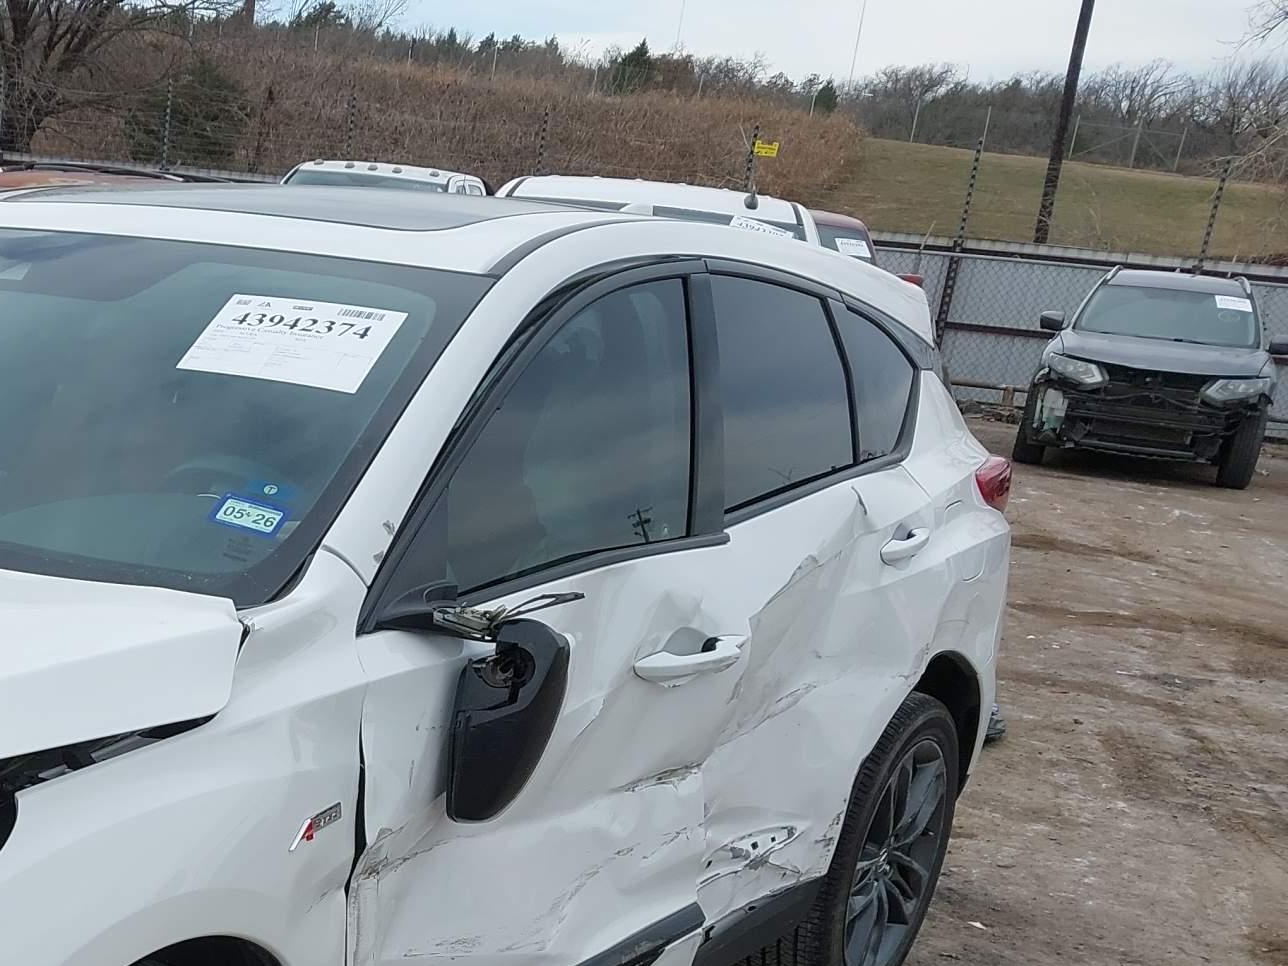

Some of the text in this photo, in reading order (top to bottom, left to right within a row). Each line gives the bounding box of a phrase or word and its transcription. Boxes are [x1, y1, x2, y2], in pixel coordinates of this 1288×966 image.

[232, 312, 373, 340] 43942374
[223, 505, 245, 520] 05
[251, 512, 277, 528] 26
